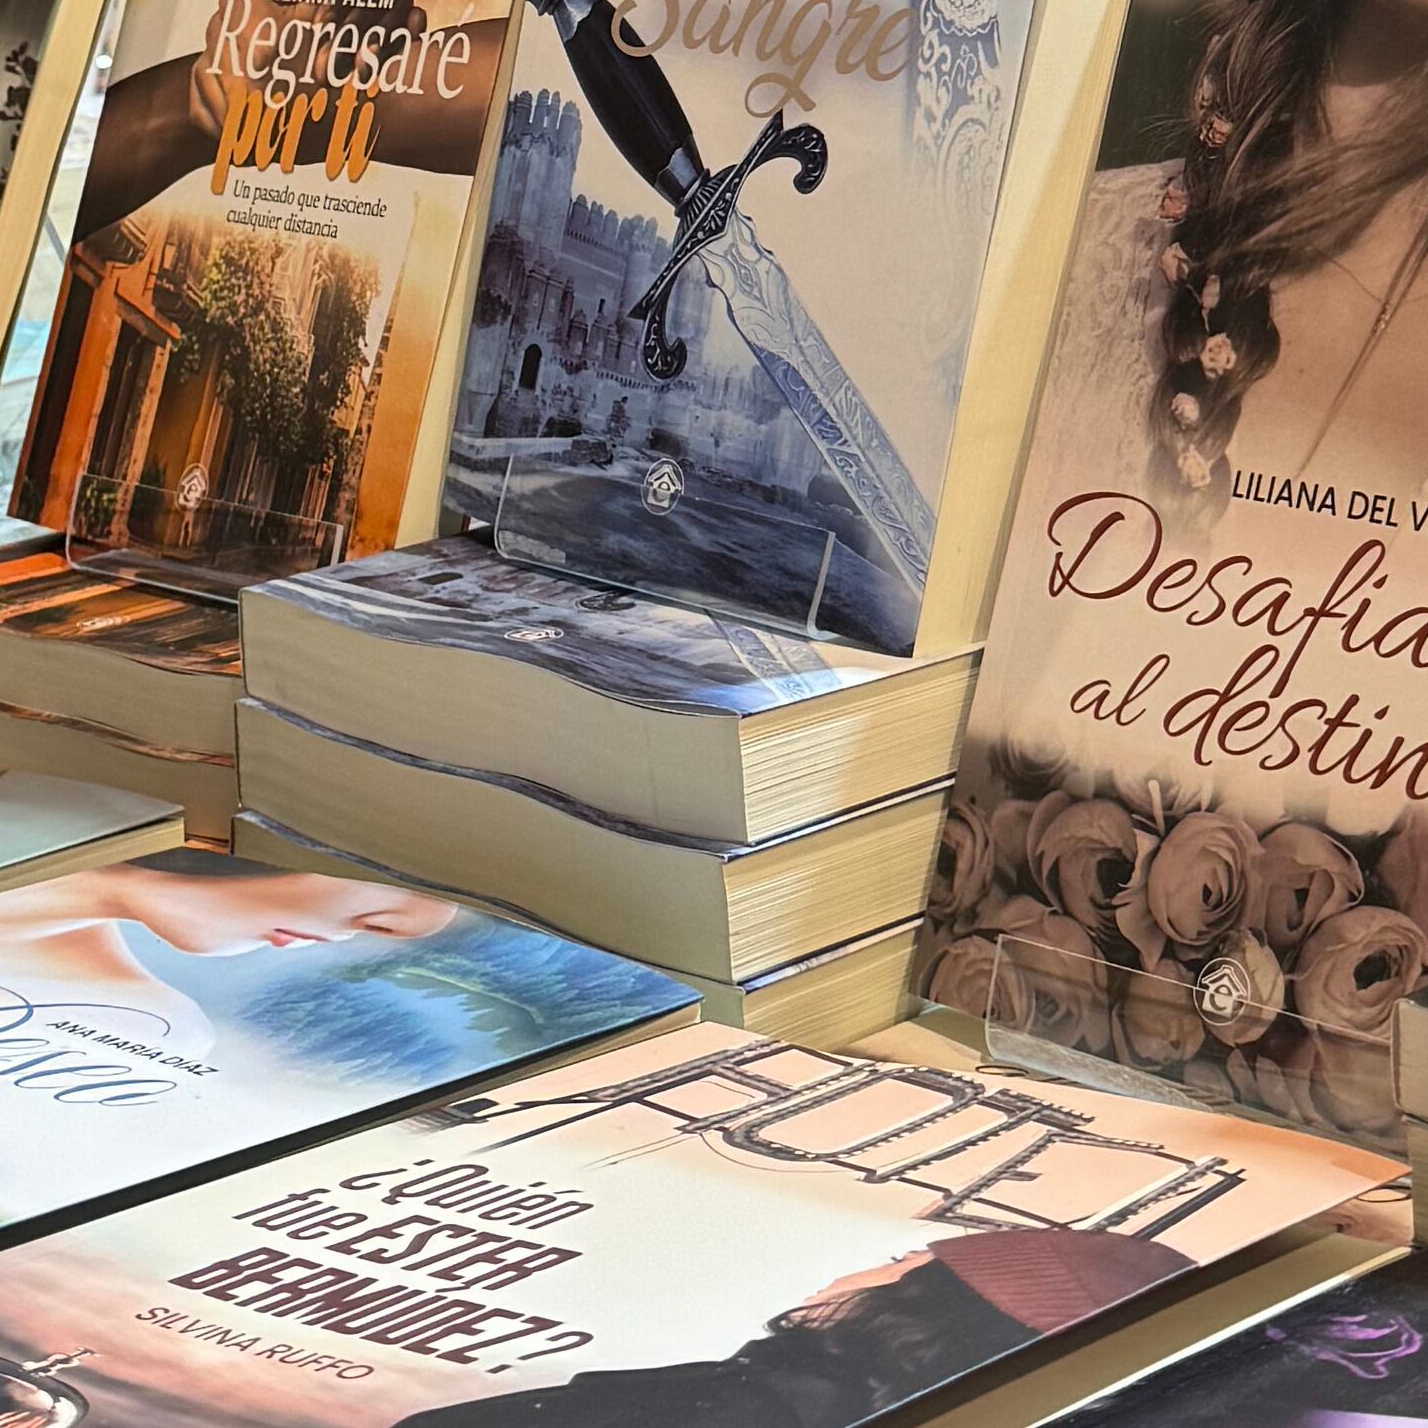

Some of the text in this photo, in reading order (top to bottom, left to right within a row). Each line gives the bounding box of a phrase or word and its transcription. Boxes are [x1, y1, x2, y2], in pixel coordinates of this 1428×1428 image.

[210, 80, 382, 196] por ti
[226, 207, 339, 240] cualquier distancia
[233, 179, 388, 219] Un pasado que trasciende
[1231, 469, 1338, 517] LILIANA
[1346, 490, 1400, 528] DEL
[1070, 653, 1171, 727] al
[46, 1019, 220, 1079] ANA MARÍA DÍAZ
[339, 1159, 594, 1230] ¿Quién
[233, 1187, 582, 1291] fue ESTER
[135, 1304, 375, 1380] SILVINA RUFFO
[168, 1246, 594, 1374] BERMÚDEZ?
